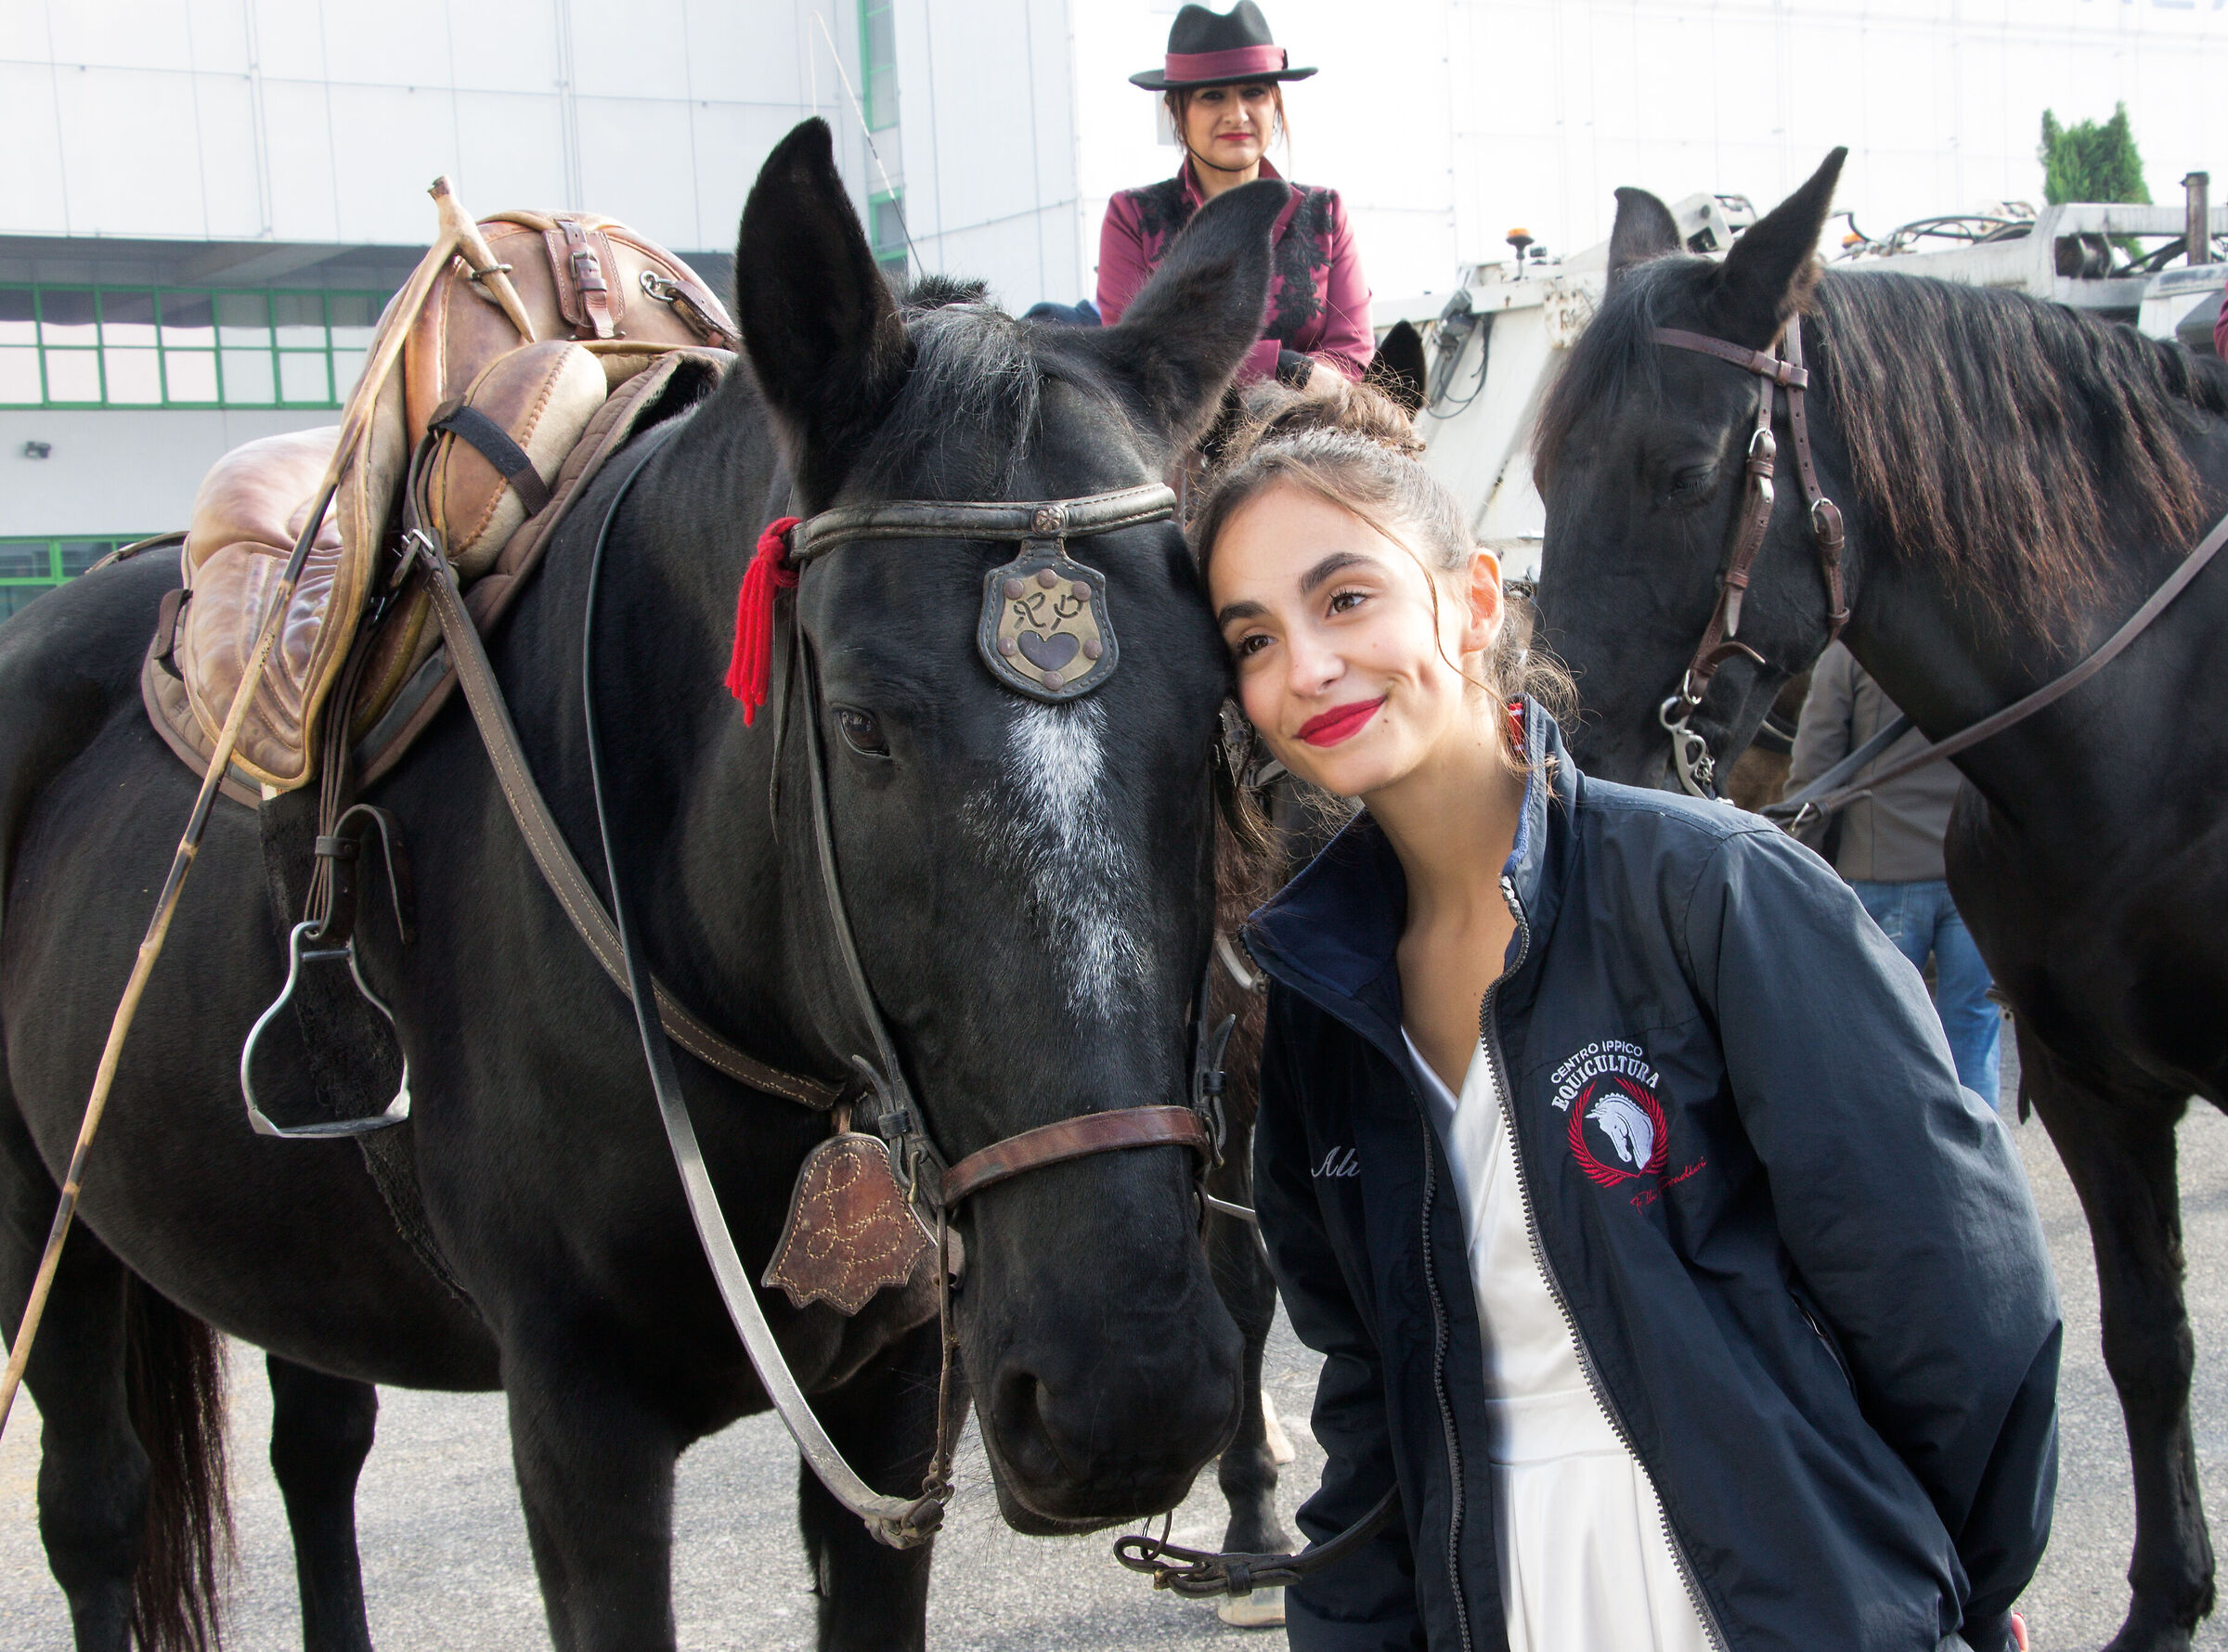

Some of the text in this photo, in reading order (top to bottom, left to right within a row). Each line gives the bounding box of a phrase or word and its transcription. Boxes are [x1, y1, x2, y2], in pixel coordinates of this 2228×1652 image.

[1550, 1039, 1643, 1084] CENTRO IPPICO
[1551, 1054, 1660, 1112] EQUICULTURA
